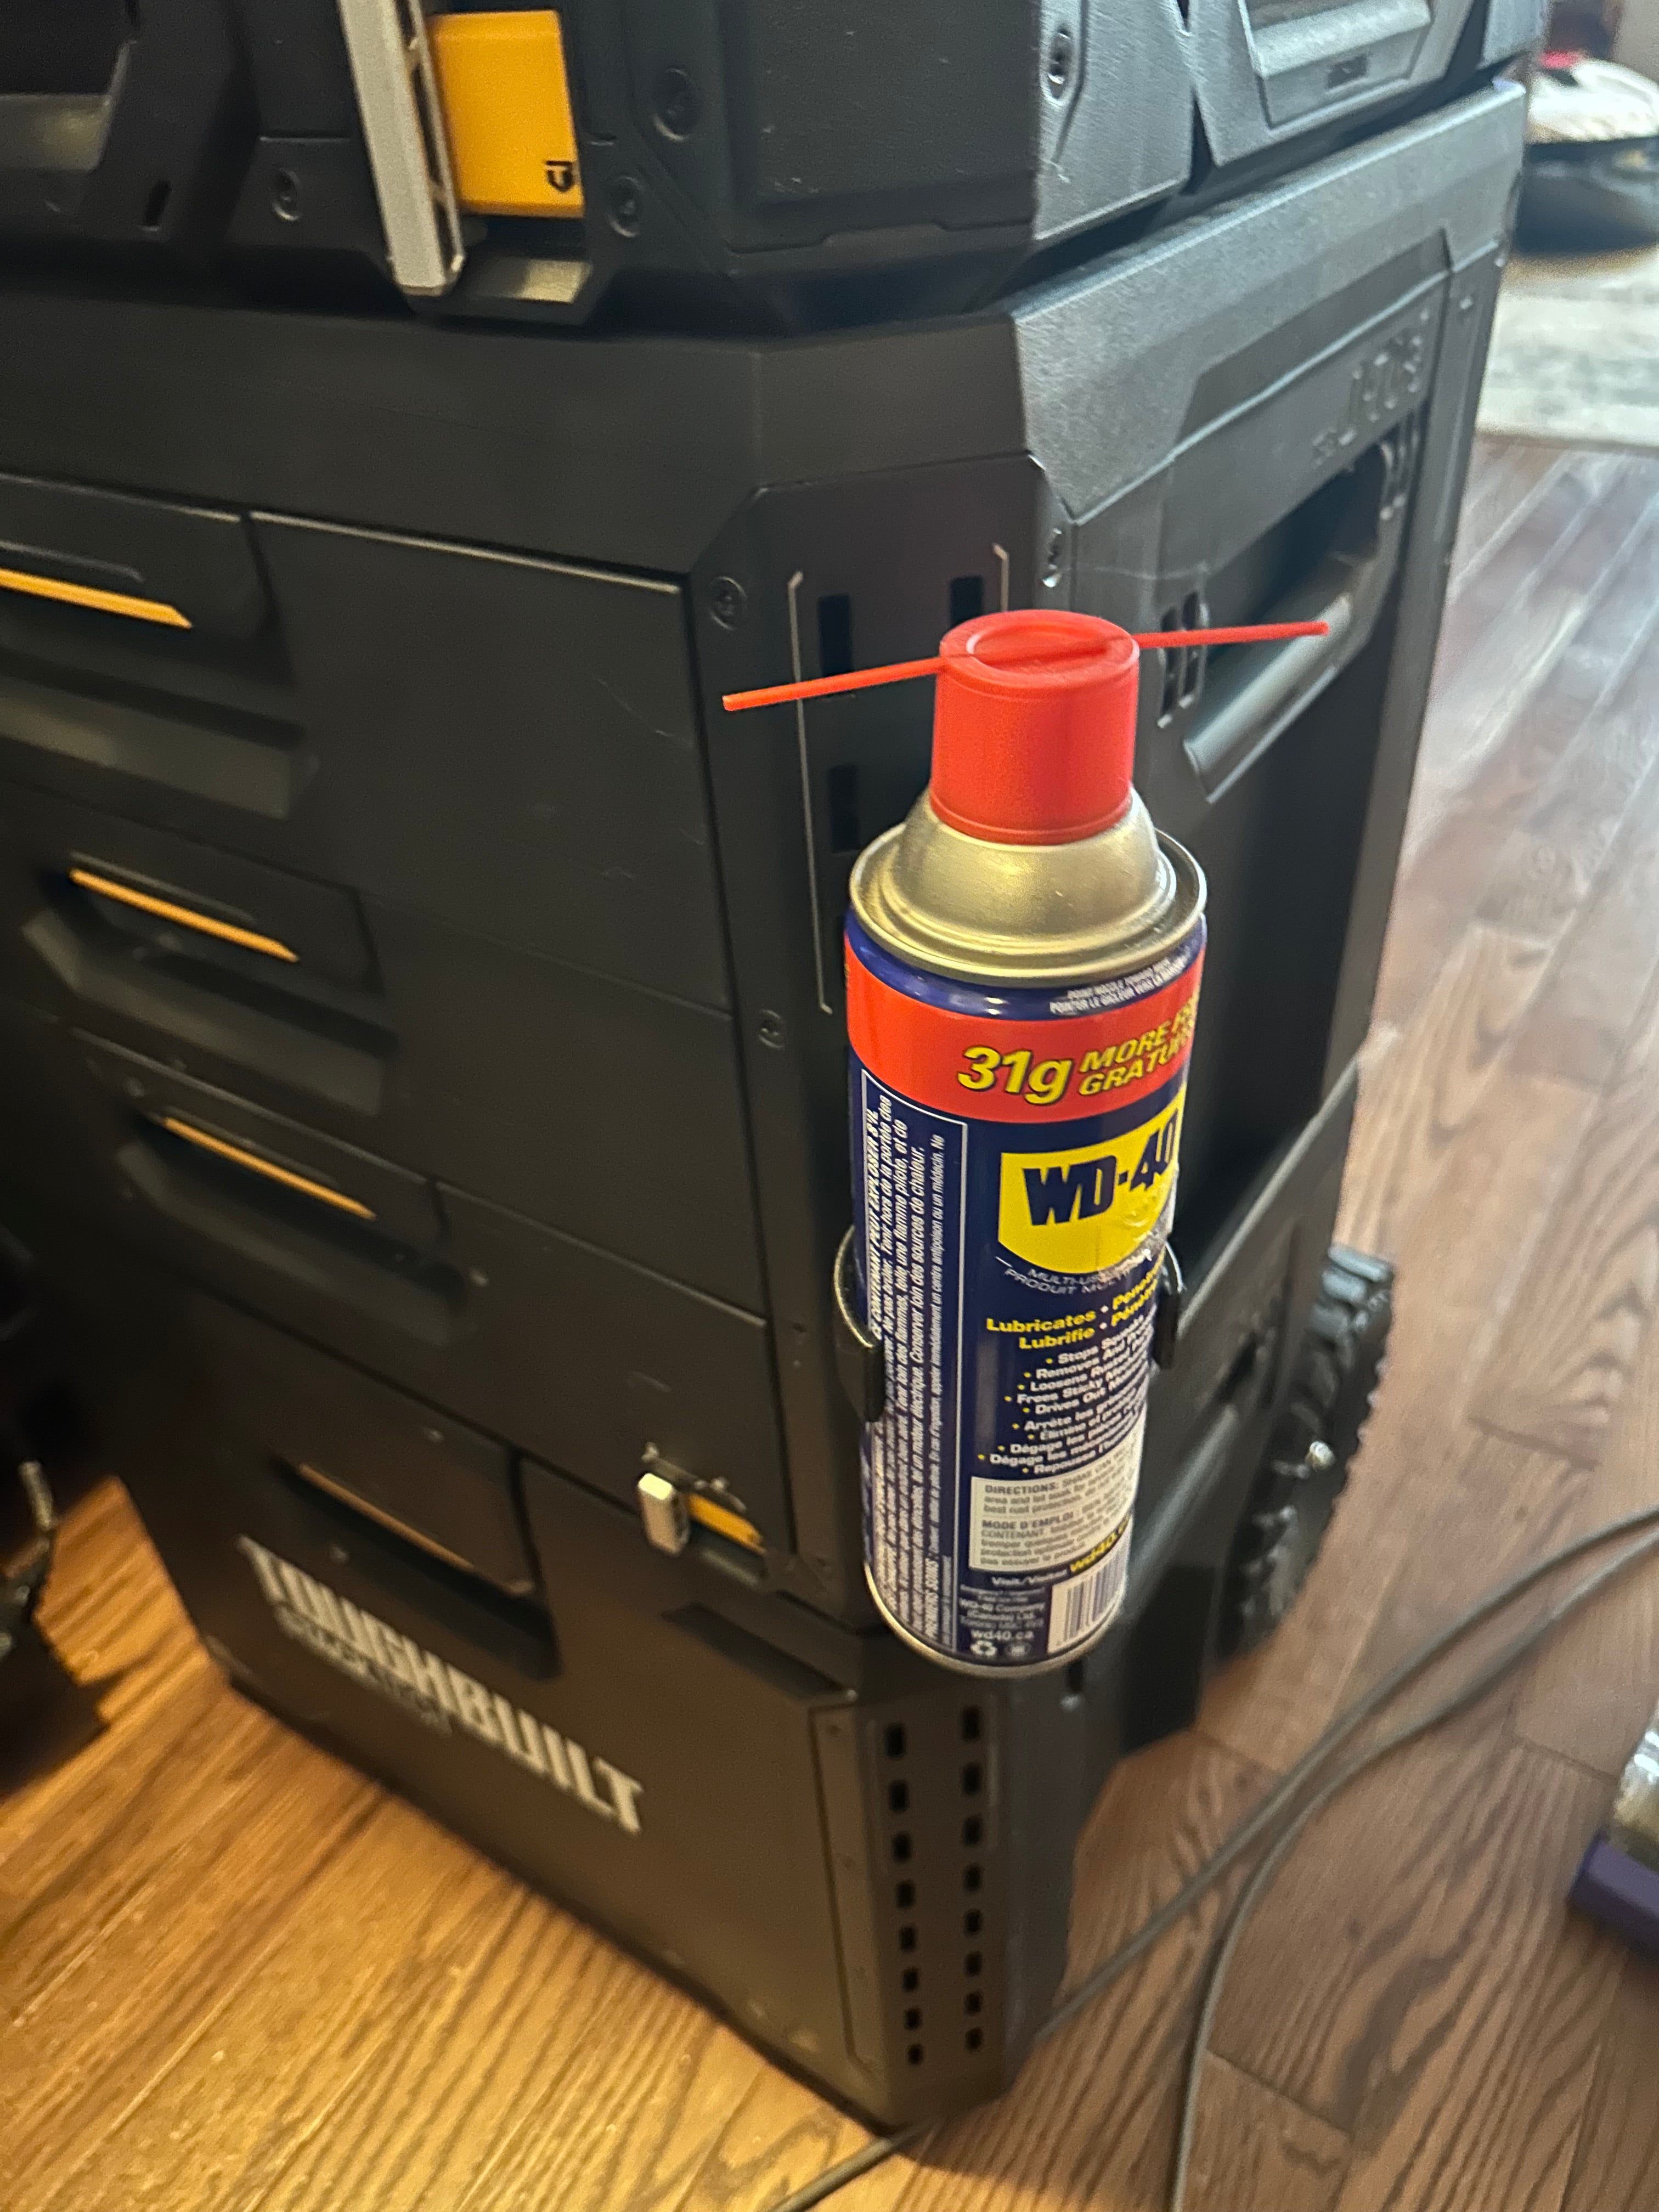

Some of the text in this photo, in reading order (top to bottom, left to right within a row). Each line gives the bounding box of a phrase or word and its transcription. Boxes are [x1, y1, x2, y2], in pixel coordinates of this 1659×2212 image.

[957, 1046, 1073, 1105] 31g
[1079, 1019, 1172, 1073] MORE
[1022, 1108, 1178, 1226] WD-40
[986, 1310, 1096, 1332] Lubricates
[1020, 1328, 1095, 1349] Lubrifie
